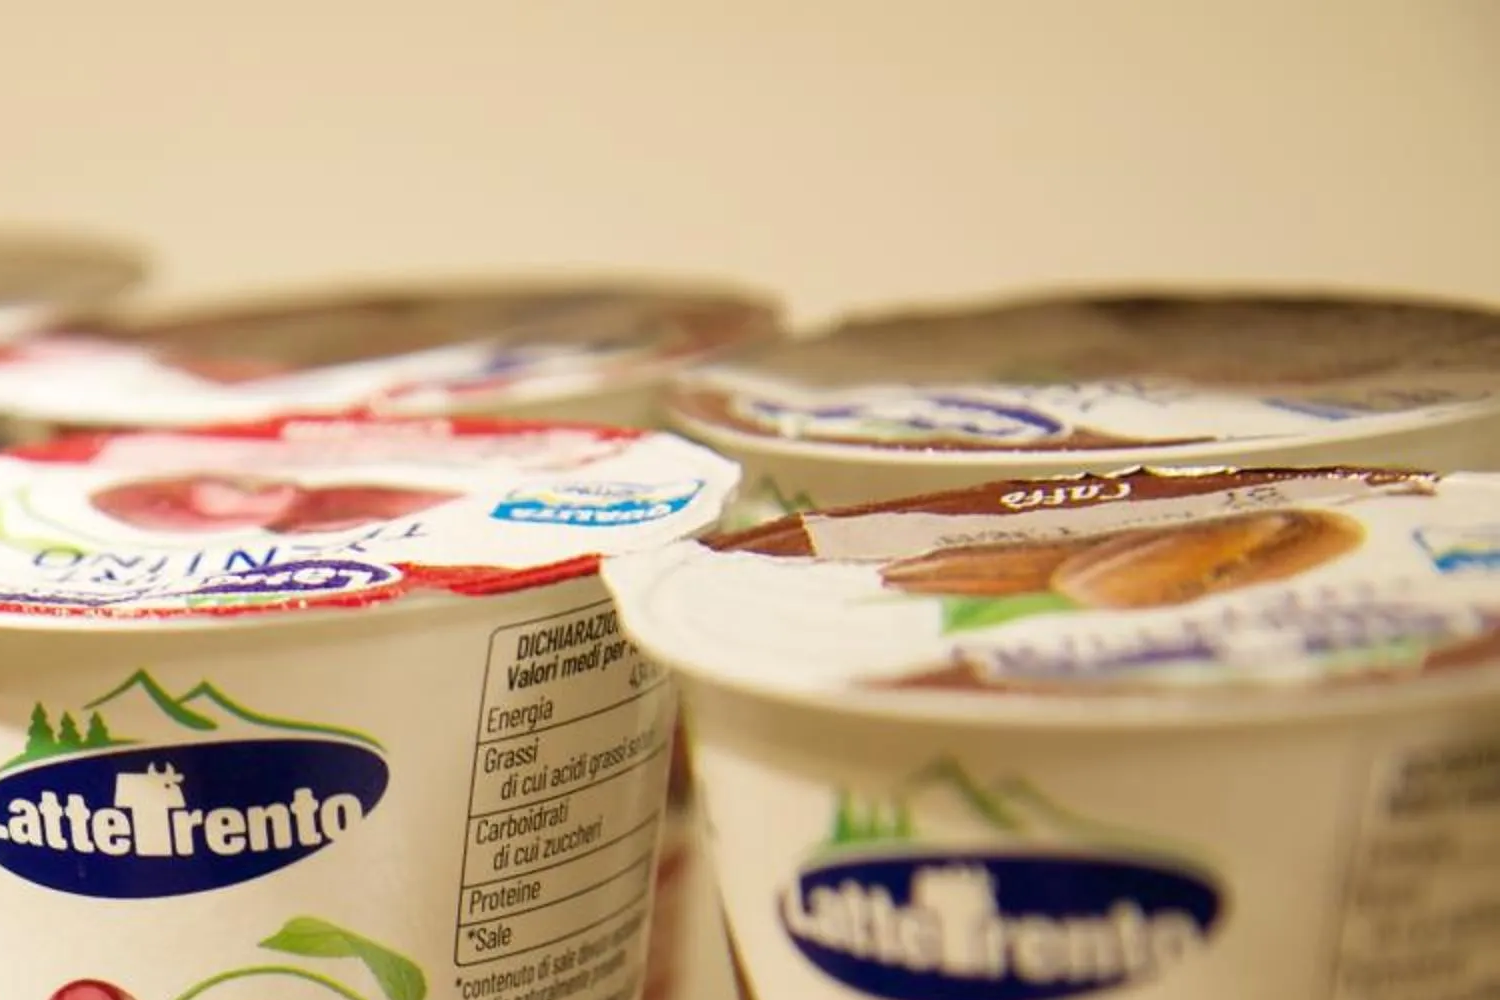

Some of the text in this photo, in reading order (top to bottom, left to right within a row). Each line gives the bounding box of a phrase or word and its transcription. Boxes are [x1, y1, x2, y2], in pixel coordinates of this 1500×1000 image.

[517, 609, 619, 660] DICHIARAZIO
[507, 655, 559, 691] Valori
[561, 642, 602, 678] medi
[602, 640, 627, 671] per
[487, 696, 553, 732] Energia
[484, 736, 539, 773] Grassi
[501, 774, 518, 800] di
[522, 765, 548, 795] cui
[550, 753, 587, 787] acidi
[476, 796, 570, 844] Carboidrati
[494, 814, 603, 871] di cui zuccheri
[469, 878, 541, 915] Proteine
